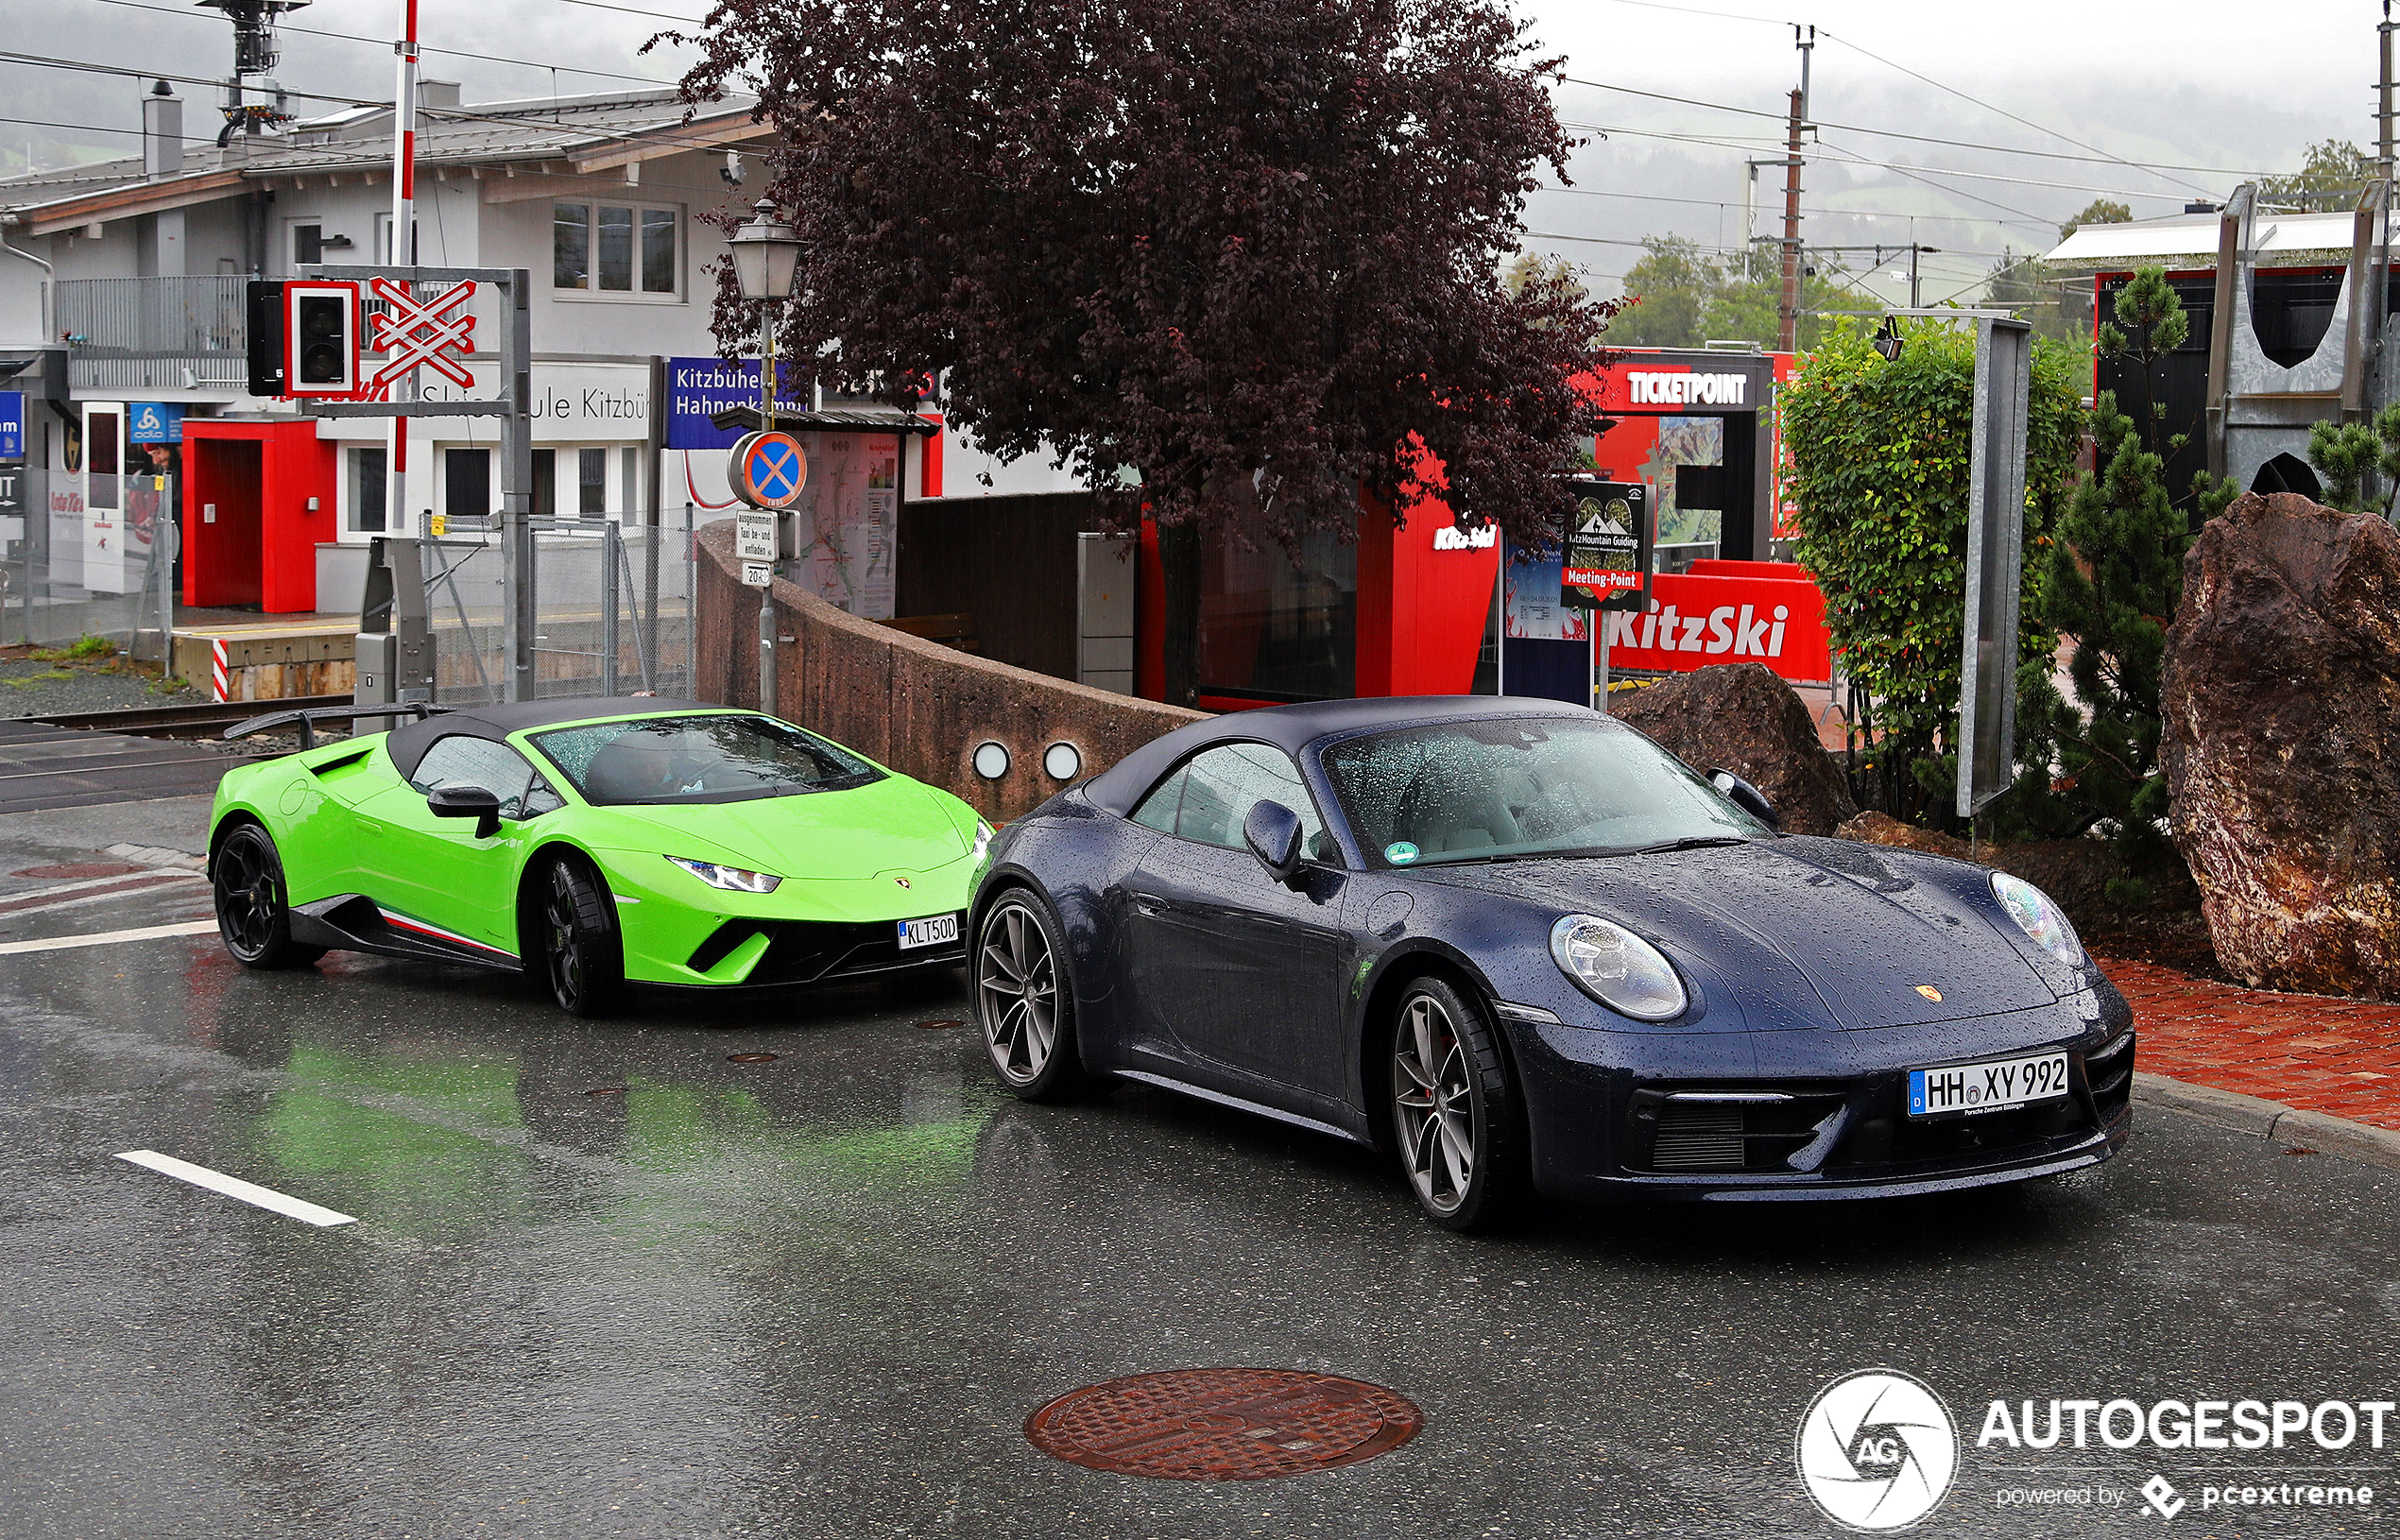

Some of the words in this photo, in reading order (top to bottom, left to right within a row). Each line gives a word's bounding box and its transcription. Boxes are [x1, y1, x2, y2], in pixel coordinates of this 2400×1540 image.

[276, 368, 283, 378] 5
[1627, 371, 1748, 404] TICKETPOINT
[738, 514, 772, 526] ausgenommen
[741, 526, 750, 539] Taxi
[762, 530, 771, 541] und
[745, 543, 766, 556] entladen
[1612, 535, 1638, 550] Guiding
[1569, 569, 1637, 588] Meeting-Point
[1608, 598, 1790, 658] KitzSki
[1913, 1097, 1921, 1107] D
[1928, 1071, 1964, 1108] HH
[1983, 1065, 2016, 1102] XY
[2022, 1058, 2066, 1096] 992
[1964, 1107, 1984, 1117] Porsche
